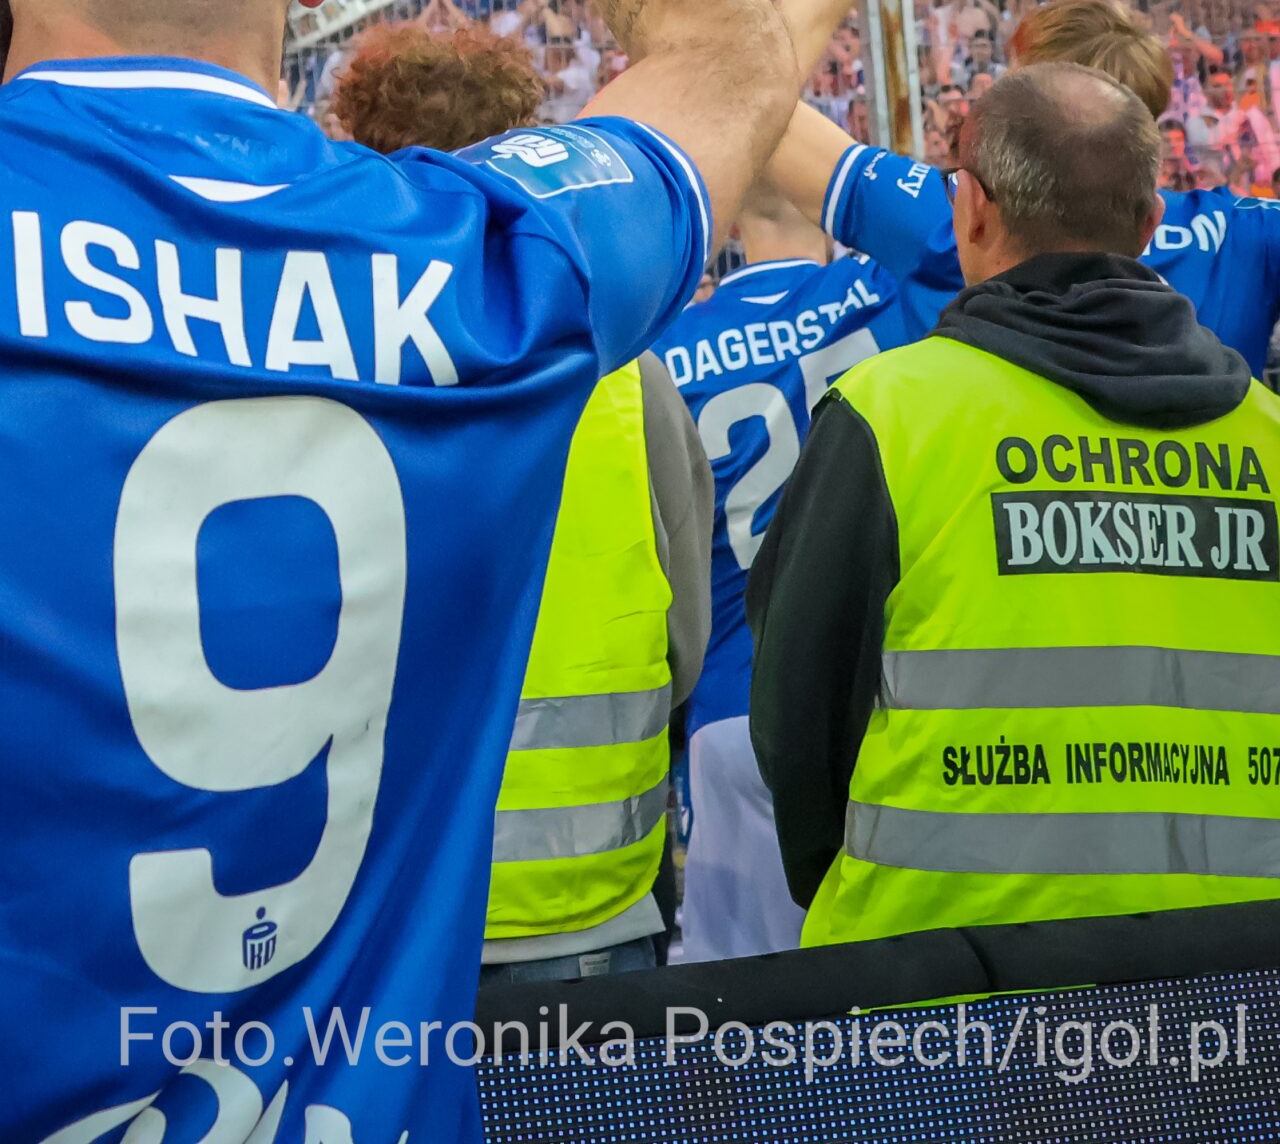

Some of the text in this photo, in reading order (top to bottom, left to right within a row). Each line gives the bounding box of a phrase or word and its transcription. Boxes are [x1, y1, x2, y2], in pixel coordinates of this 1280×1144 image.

[12, 210, 459, 386] ISHAK
[995, 434, 1271, 494] OCHRONA
[1003, 500, 1270, 571] BOKSER JR
[113, 394, 407, 994] 9
[942, 735, 1051, 786] SŁUŻBA
[1066, 742, 1231, 786] INFORMACYJNA
